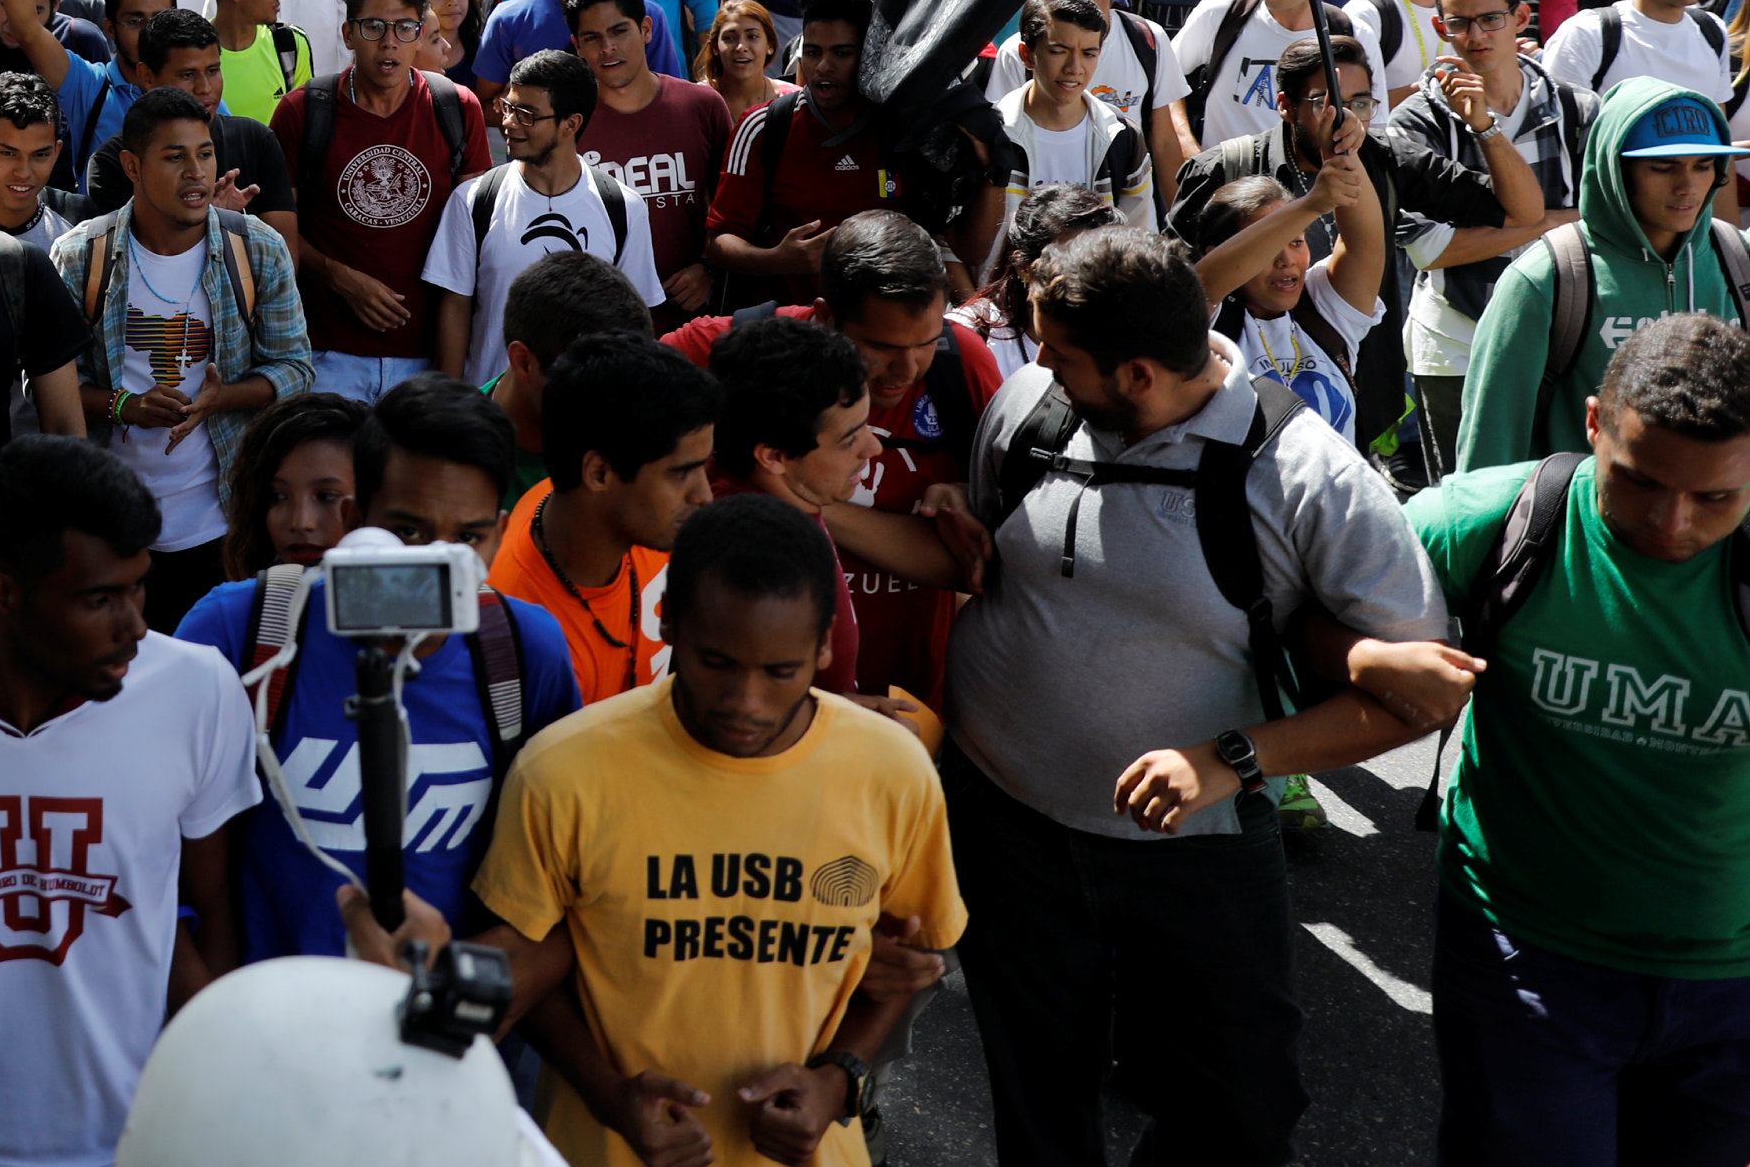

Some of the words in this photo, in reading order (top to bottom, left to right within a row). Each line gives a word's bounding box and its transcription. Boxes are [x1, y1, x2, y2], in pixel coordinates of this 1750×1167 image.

[342, 147, 391, 181] UNIVERSIDAD
[392, 149, 426, 177] CENTRAL
[344, 202, 378, 226] CARACAS
[385, 197, 426, 226] VENEZUELA
[1530, 647, 1750, 747] UMA
[21, 873, 38, 887] DE
[39, 878, 106, 898] HUMBOLDT
[647, 854, 699, 899] LA
[711, 852, 803, 903] USB
[644, 915, 856, 967] PRESENTE
